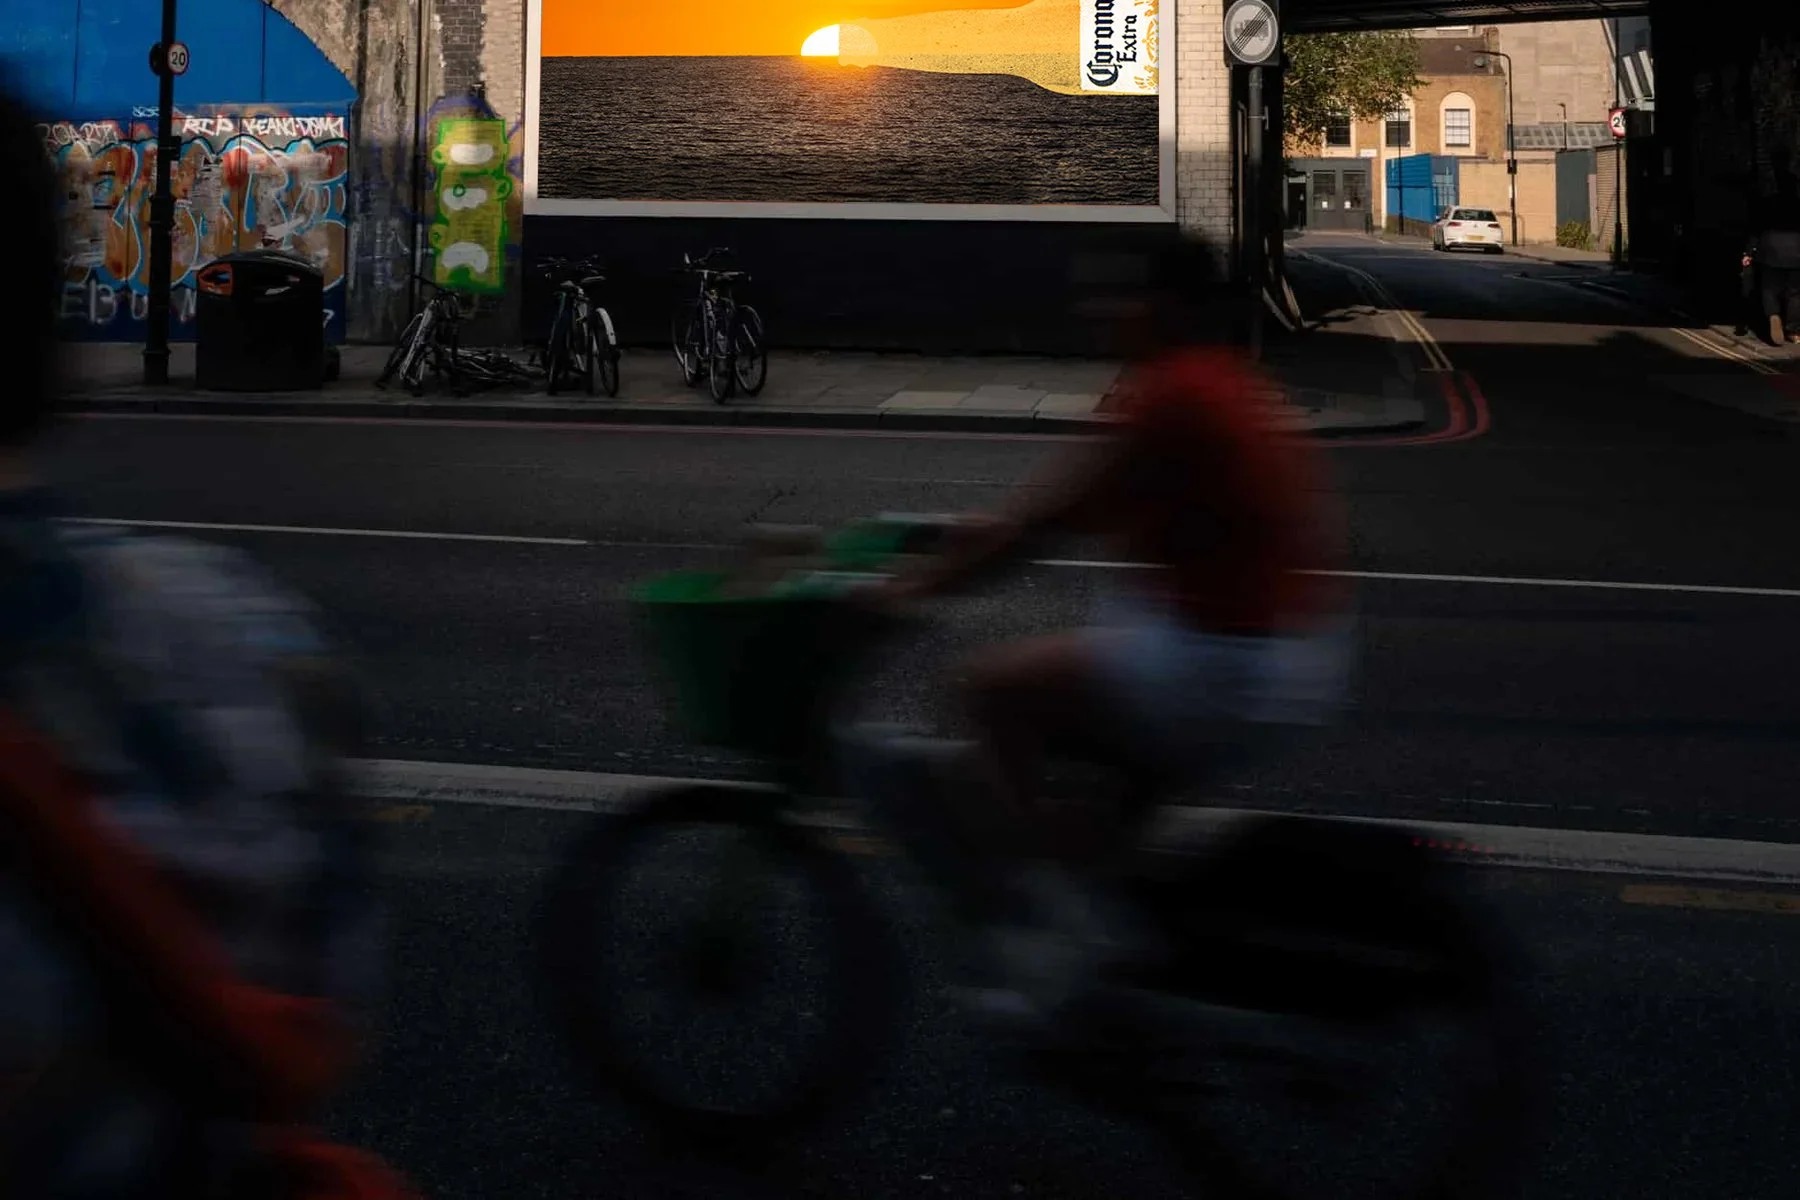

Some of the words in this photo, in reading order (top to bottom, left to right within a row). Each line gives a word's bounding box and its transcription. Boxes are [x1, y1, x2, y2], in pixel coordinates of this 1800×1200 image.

[1116, 14, 1138, 63] Extra
[171, 51, 186, 66] 20
[182, 115, 234, 136] RIP
